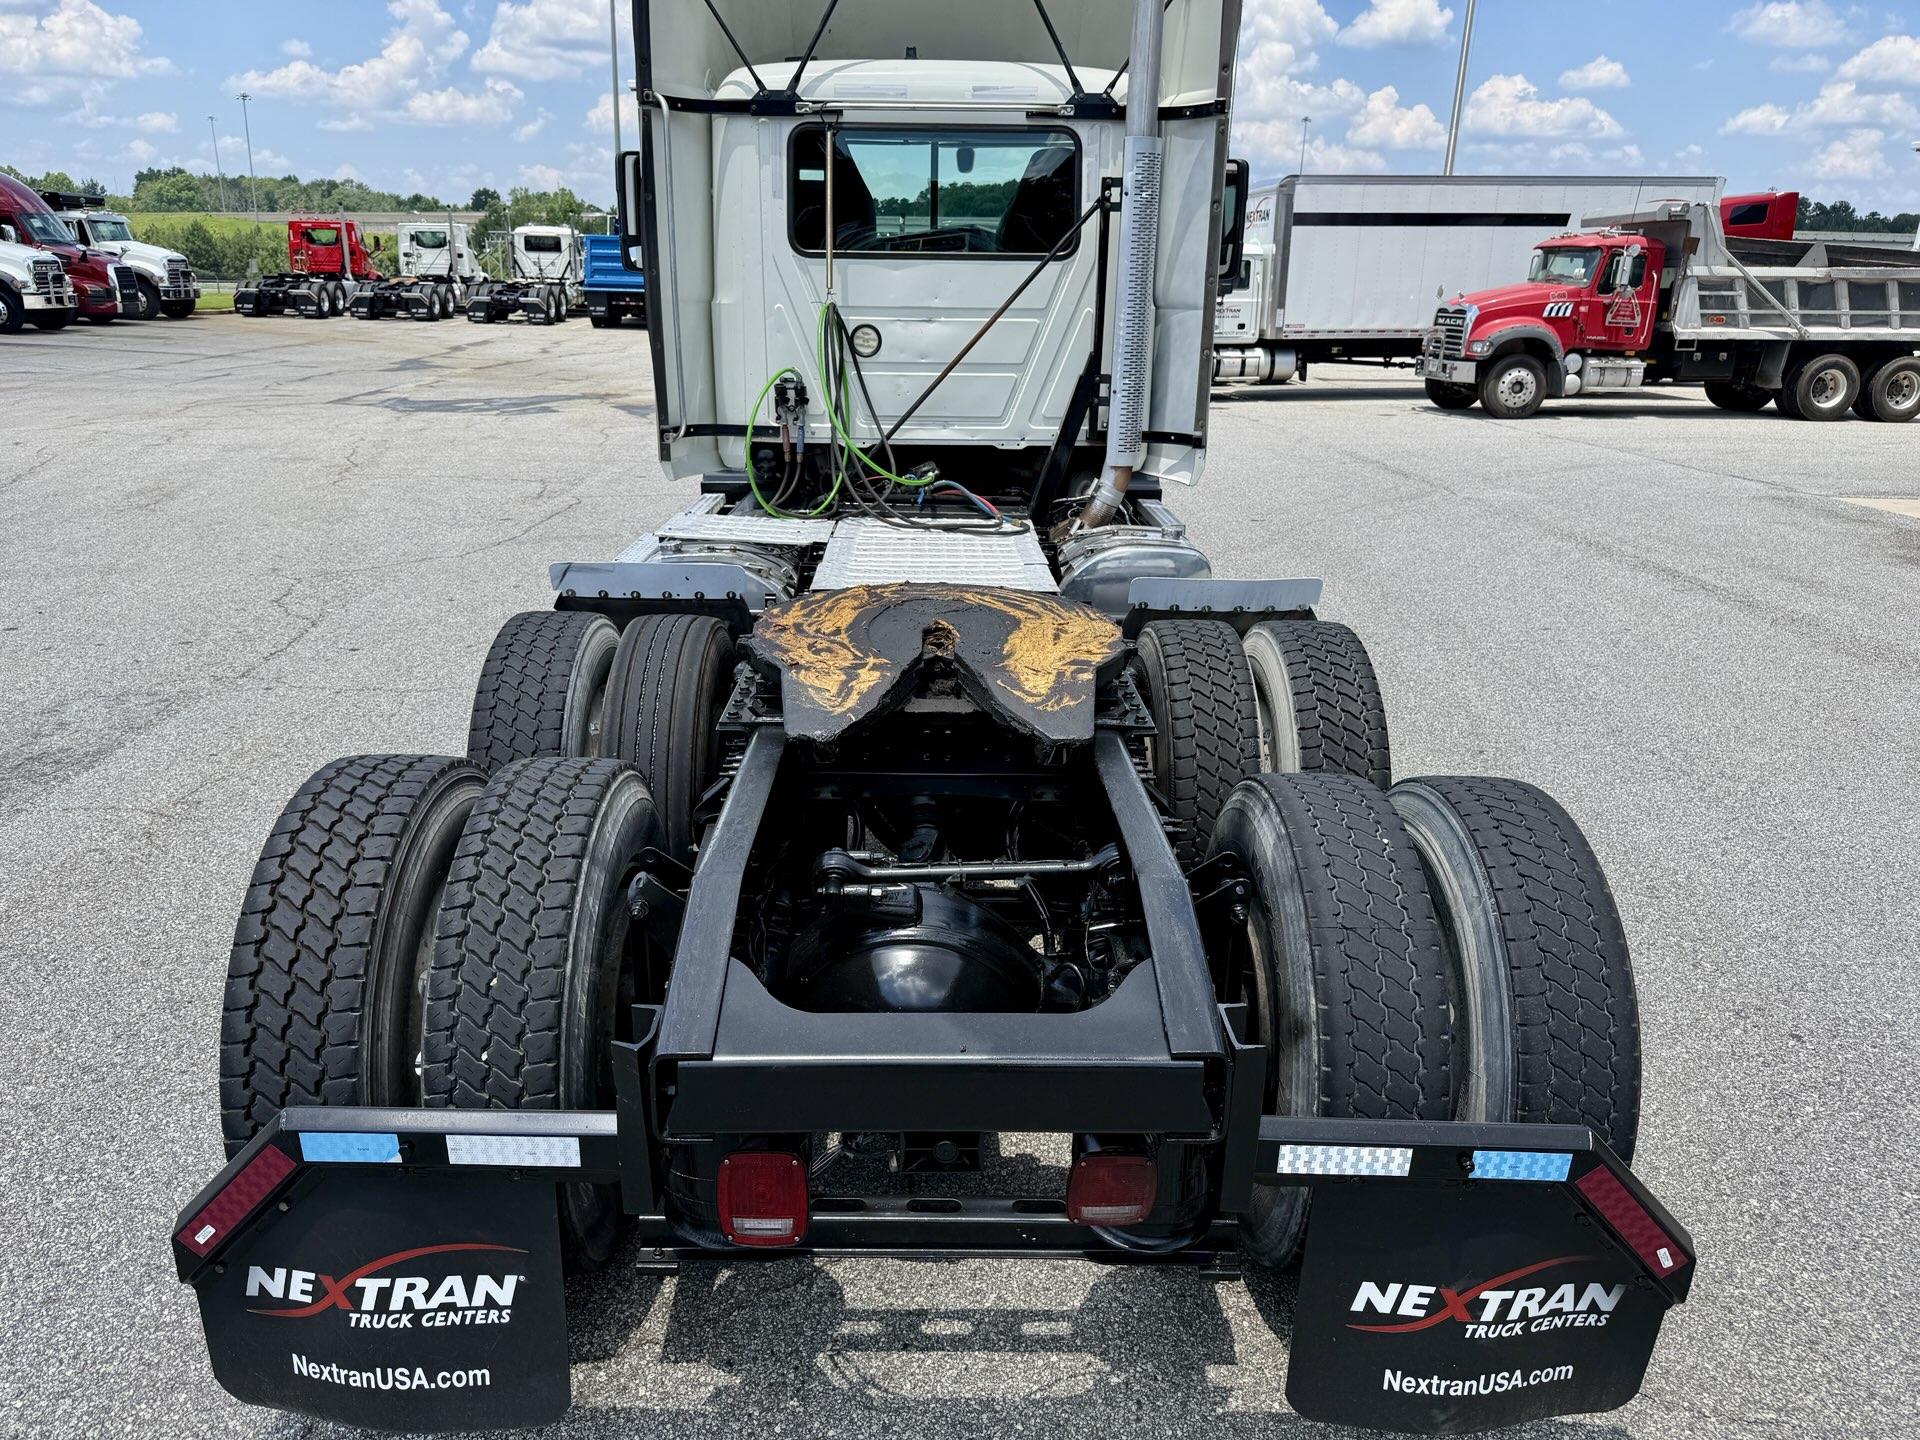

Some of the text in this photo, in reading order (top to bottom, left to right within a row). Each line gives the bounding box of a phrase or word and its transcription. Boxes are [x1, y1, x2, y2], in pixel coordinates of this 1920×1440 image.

[1437, 317, 1463, 325] MACK
[1350, 1281, 1628, 1322] NEXTRAN
[349, 1309, 511, 1329] TRUCK CENTERS
[1464, 1313, 1610, 1338] TRUCK CENTERS
[291, 1353, 491, 1390] NextranUSA.com
[1383, 1363, 1574, 1396] NextranUSA.com
